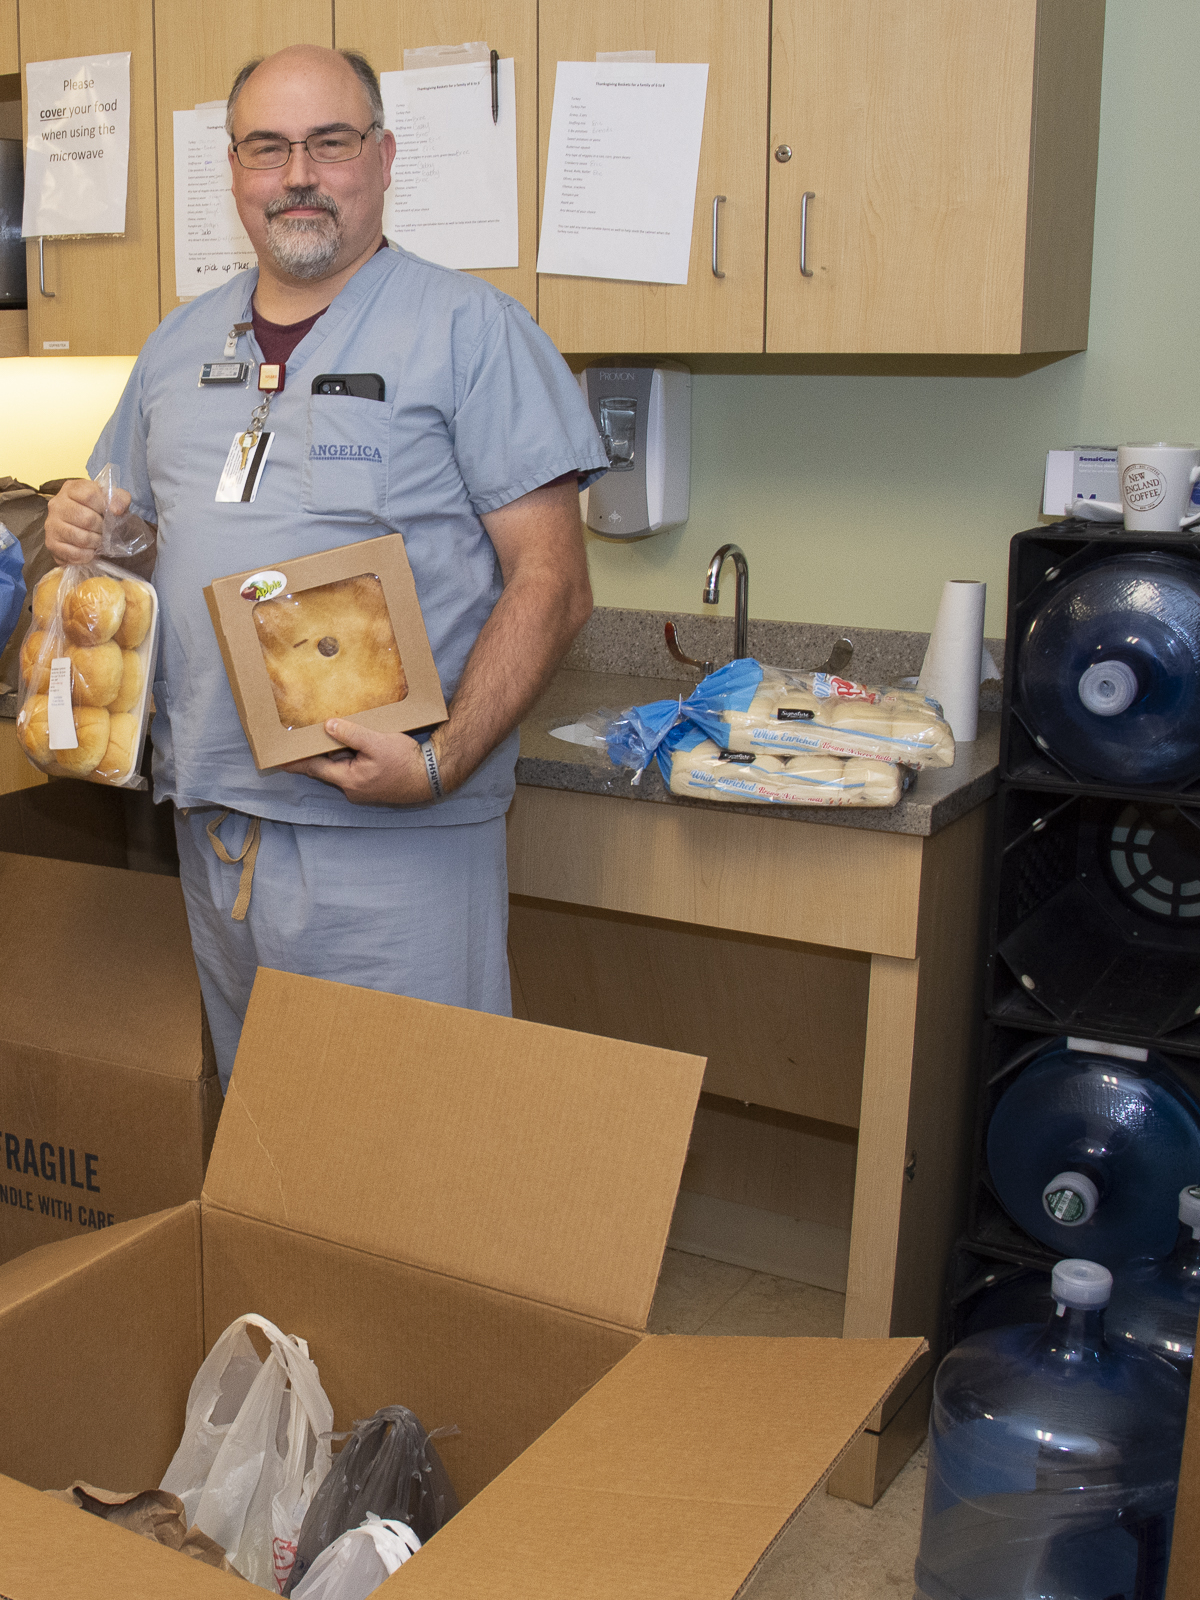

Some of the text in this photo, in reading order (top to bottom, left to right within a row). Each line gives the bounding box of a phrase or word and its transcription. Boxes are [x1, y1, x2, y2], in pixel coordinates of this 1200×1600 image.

[63, 78, 95, 91] Please
[40, 99, 118, 120] cover your food
[41, 123, 115, 141] when using the
[49, 149, 104, 162] microwave
[204, 263, 218, 275] pick
[222, 265, 231, 273] up
[309, 444, 382, 459] ANGELICA
[1128, 471, 1145, 483] NEW
[1125, 478, 1160, 495] ENGLAND
[256, 580, 282, 599] Apple
[753, 728, 779, 741] White
[780, 732, 820, 747] Enriched
[691, 770, 716, 783] White
[718, 777, 756, 792] Enriched
[38, 1194, 73, 1223] WITH
[78, 1205, 115, 1230] CARE
